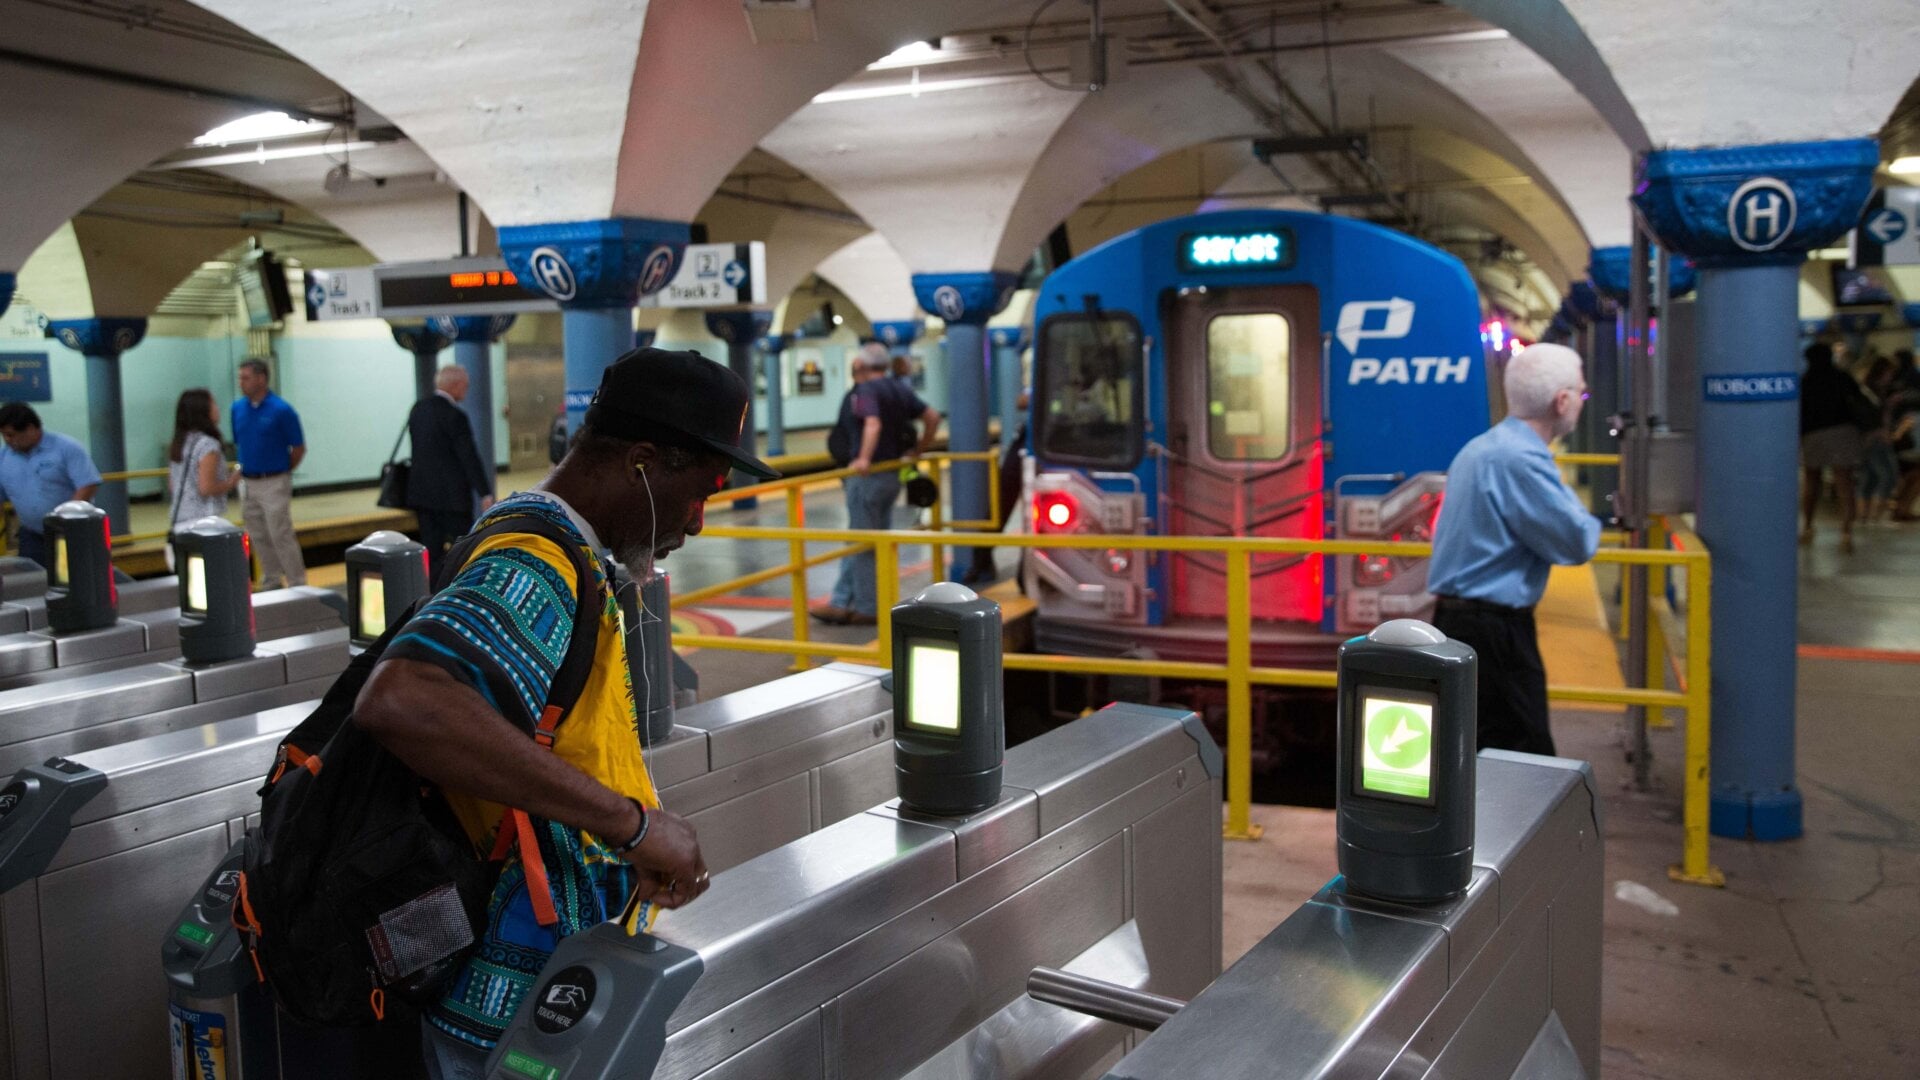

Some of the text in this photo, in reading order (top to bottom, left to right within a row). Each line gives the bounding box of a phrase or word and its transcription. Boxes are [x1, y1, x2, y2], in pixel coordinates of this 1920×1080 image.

[1745, 193, 1782, 241] H
[540, 258, 569, 293] H
[670, 283, 721, 298] Track 2
[331, 300, 360, 314] Track
[1348, 356, 1471, 385] PATH
[1707, 377, 1795, 395] HOBOKEN
[537, 1006, 573, 1027] TOUCH HERE
